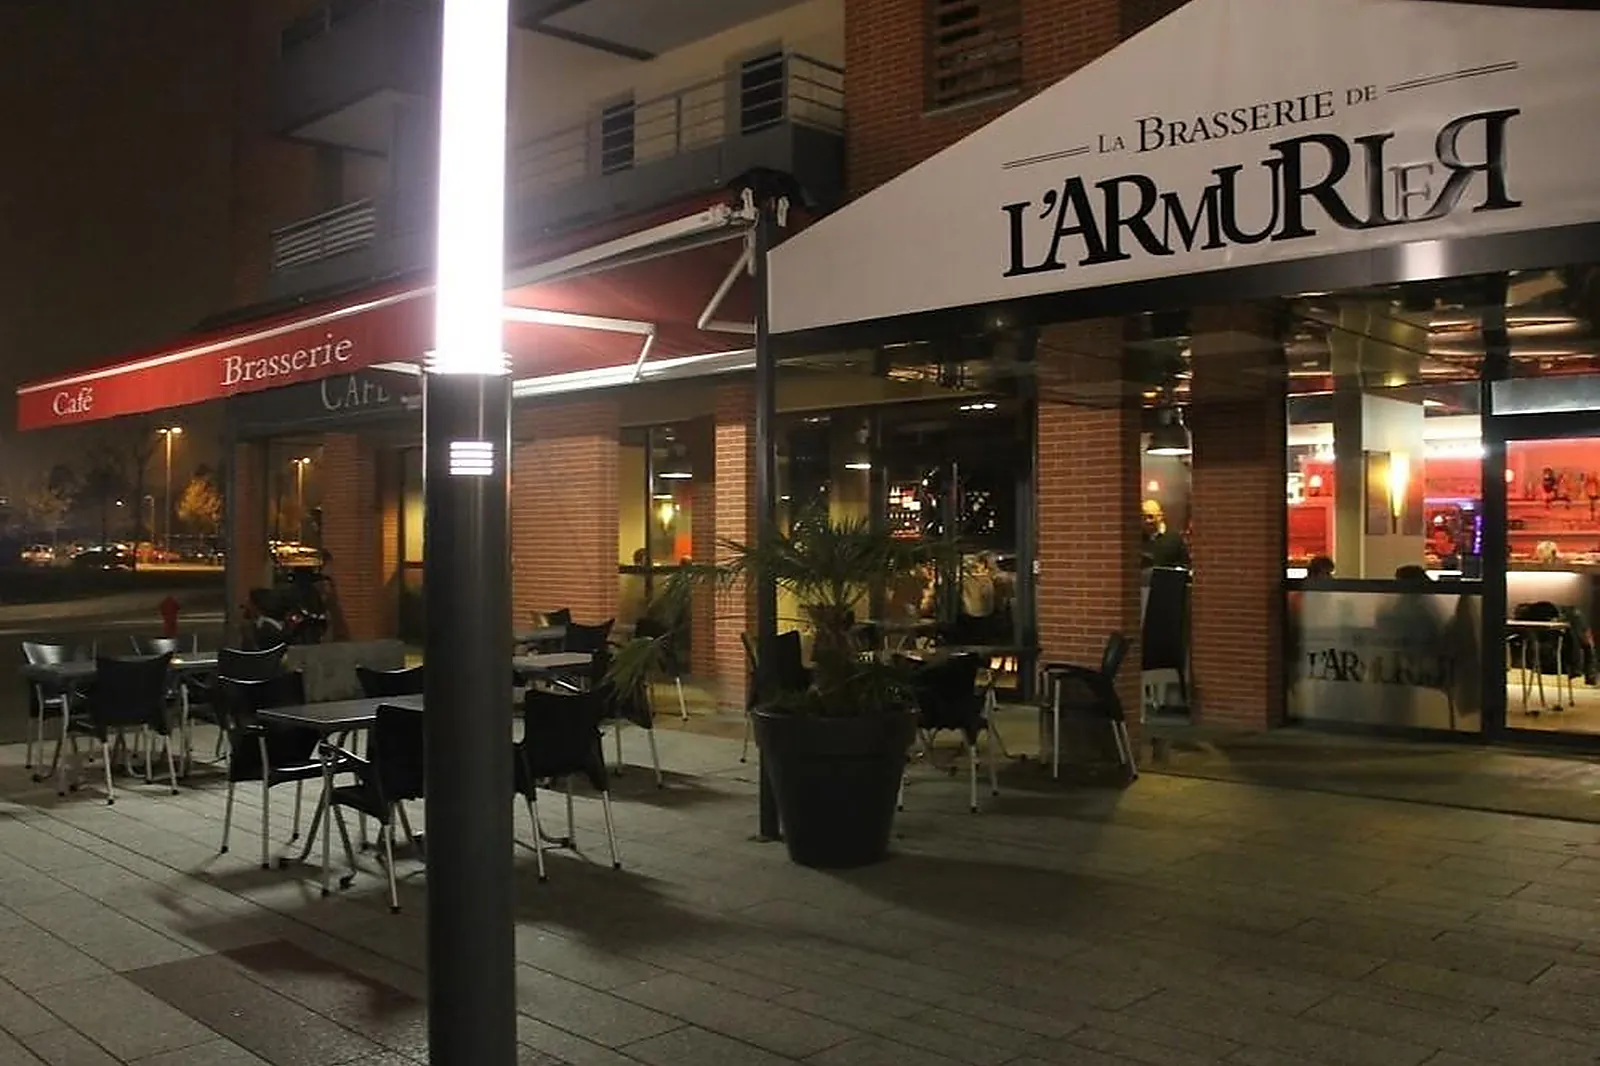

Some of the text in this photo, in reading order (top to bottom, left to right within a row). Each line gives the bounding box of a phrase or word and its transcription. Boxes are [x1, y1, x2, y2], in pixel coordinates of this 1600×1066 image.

[1098, 84, 1378, 154] LA BRASSERIE DE
[1002, 107, 1523, 278] L'ARMURIER
[220, 332, 354, 386] Brasserie
[52, 386, 94, 417] Café
